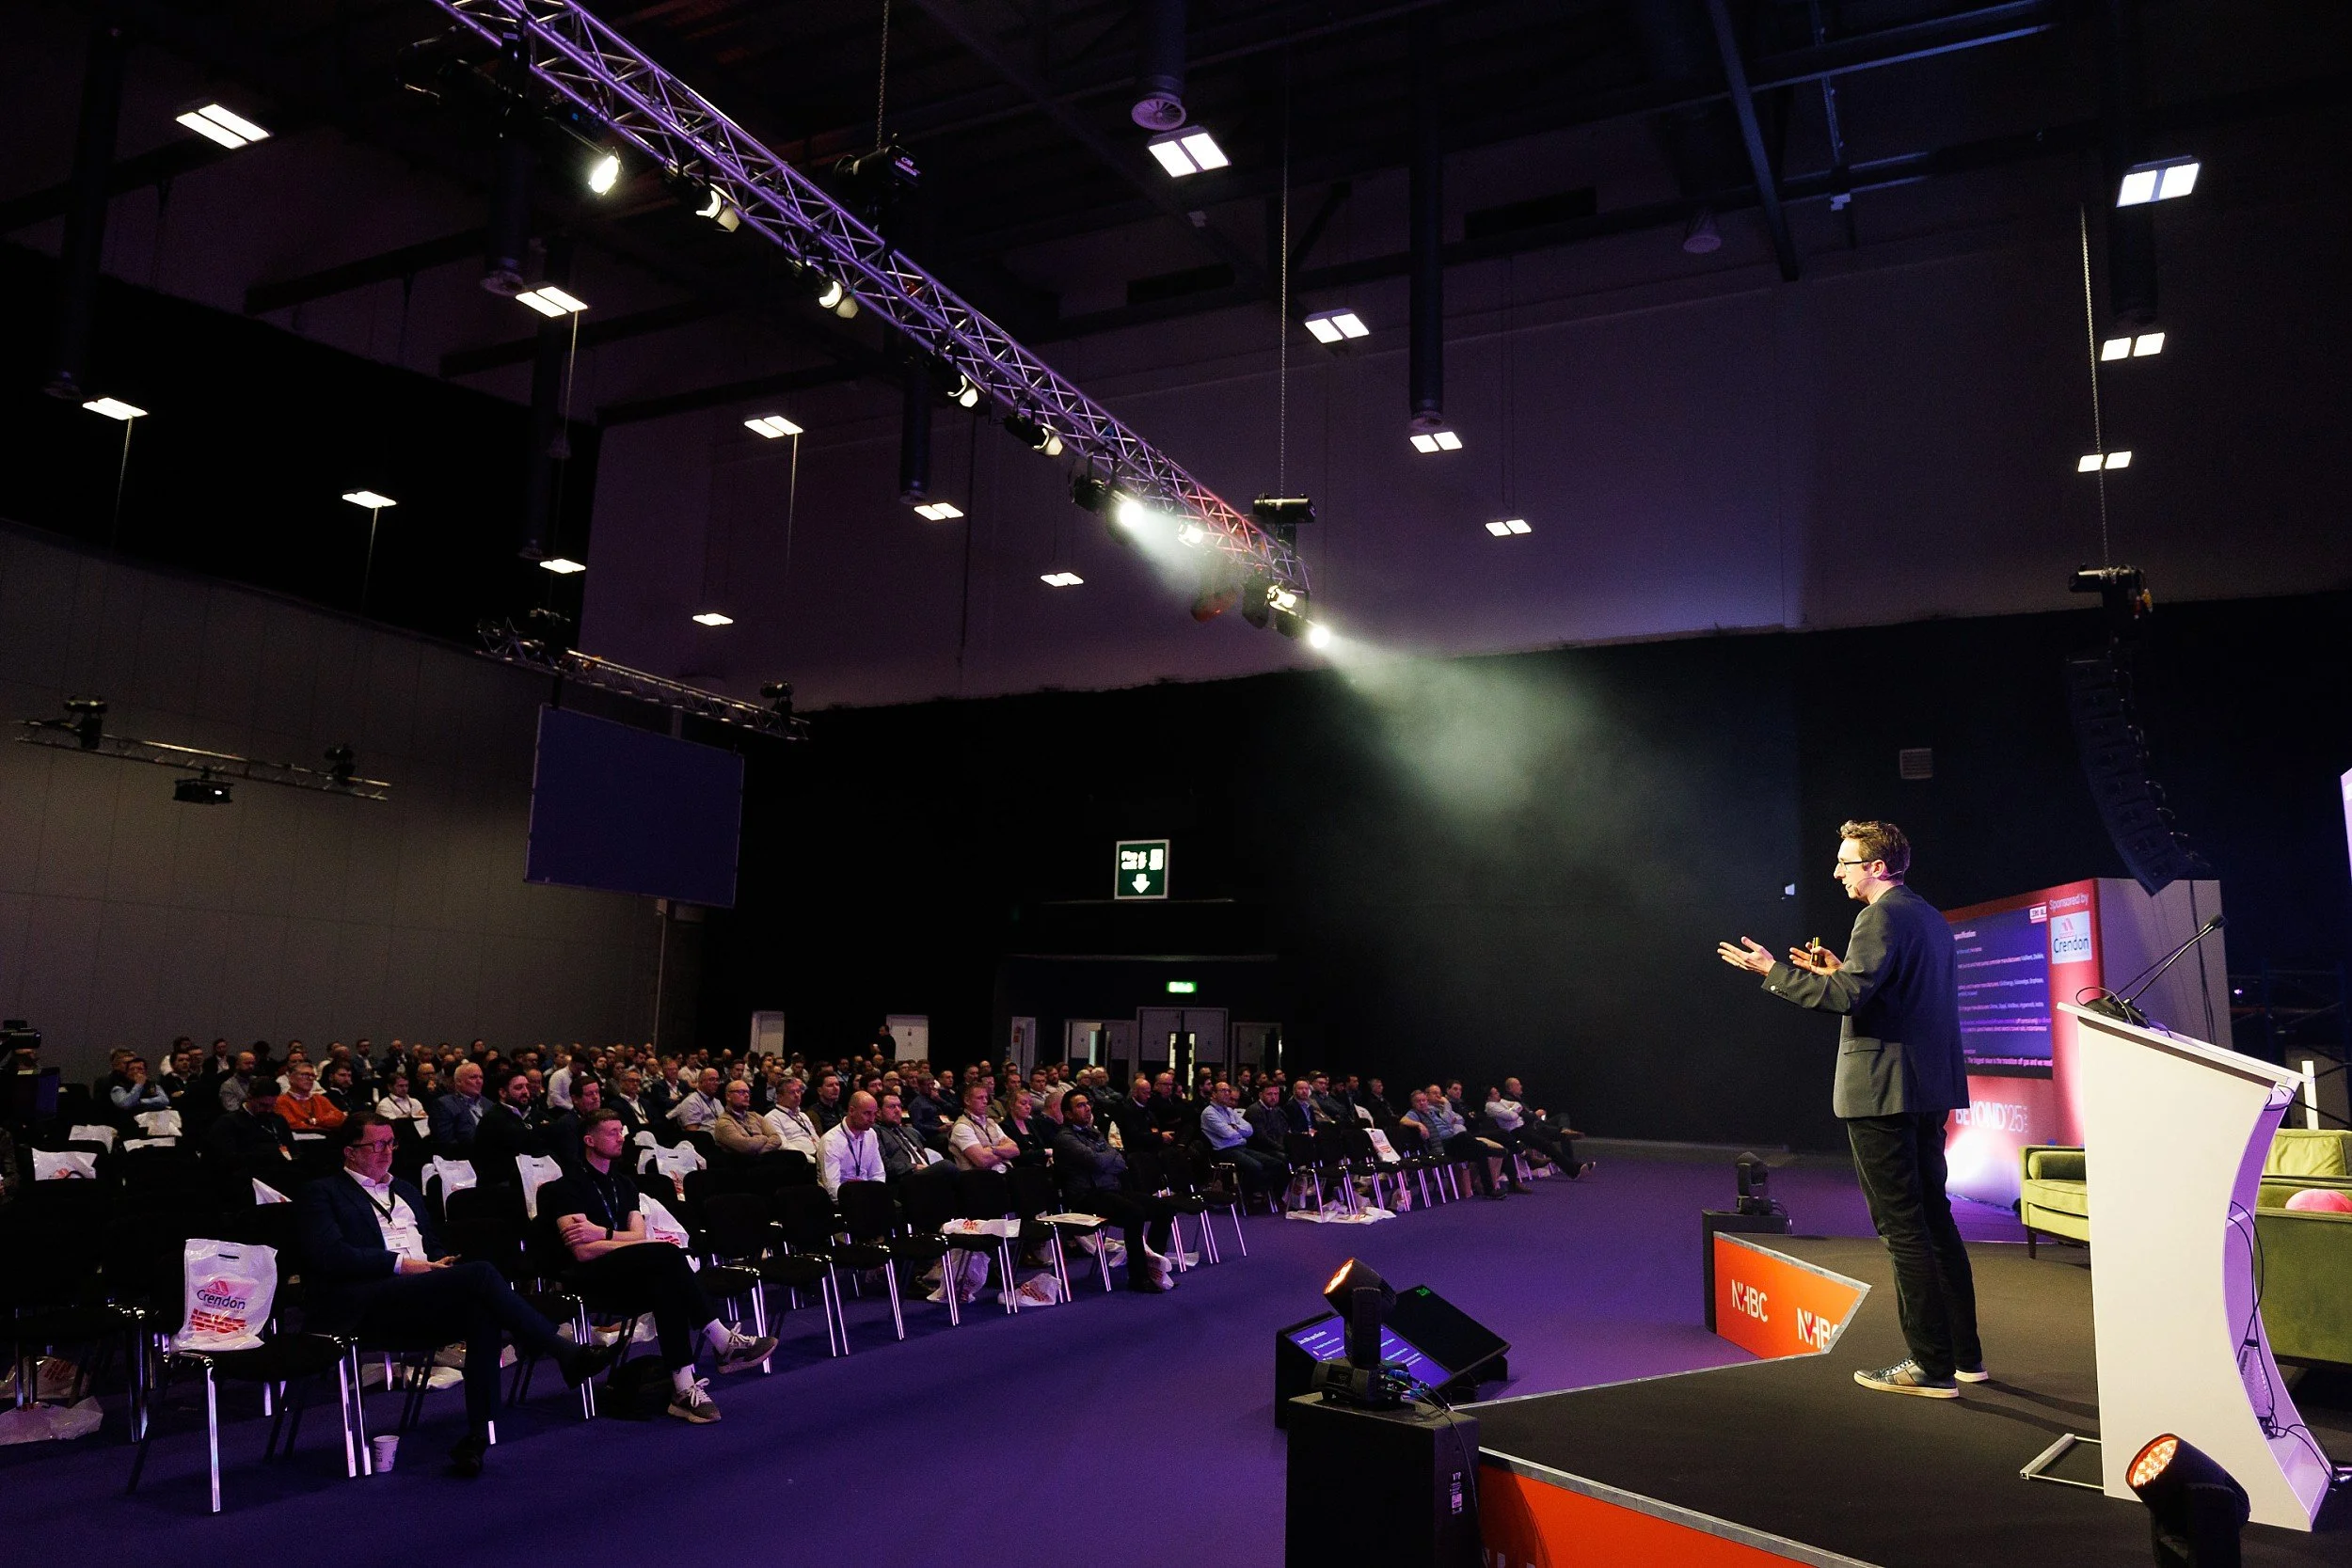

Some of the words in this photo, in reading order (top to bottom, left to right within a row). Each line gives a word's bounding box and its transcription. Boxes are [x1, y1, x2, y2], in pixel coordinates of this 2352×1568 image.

[2049, 895, 2079, 911] Sponsored
[2080, 894, 2089, 905] by
[2054, 936, 2089, 953] Crendon
[197, 1290, 246, 1309] Crendon
[1731, 1279, 1768, 1323] NHBC
